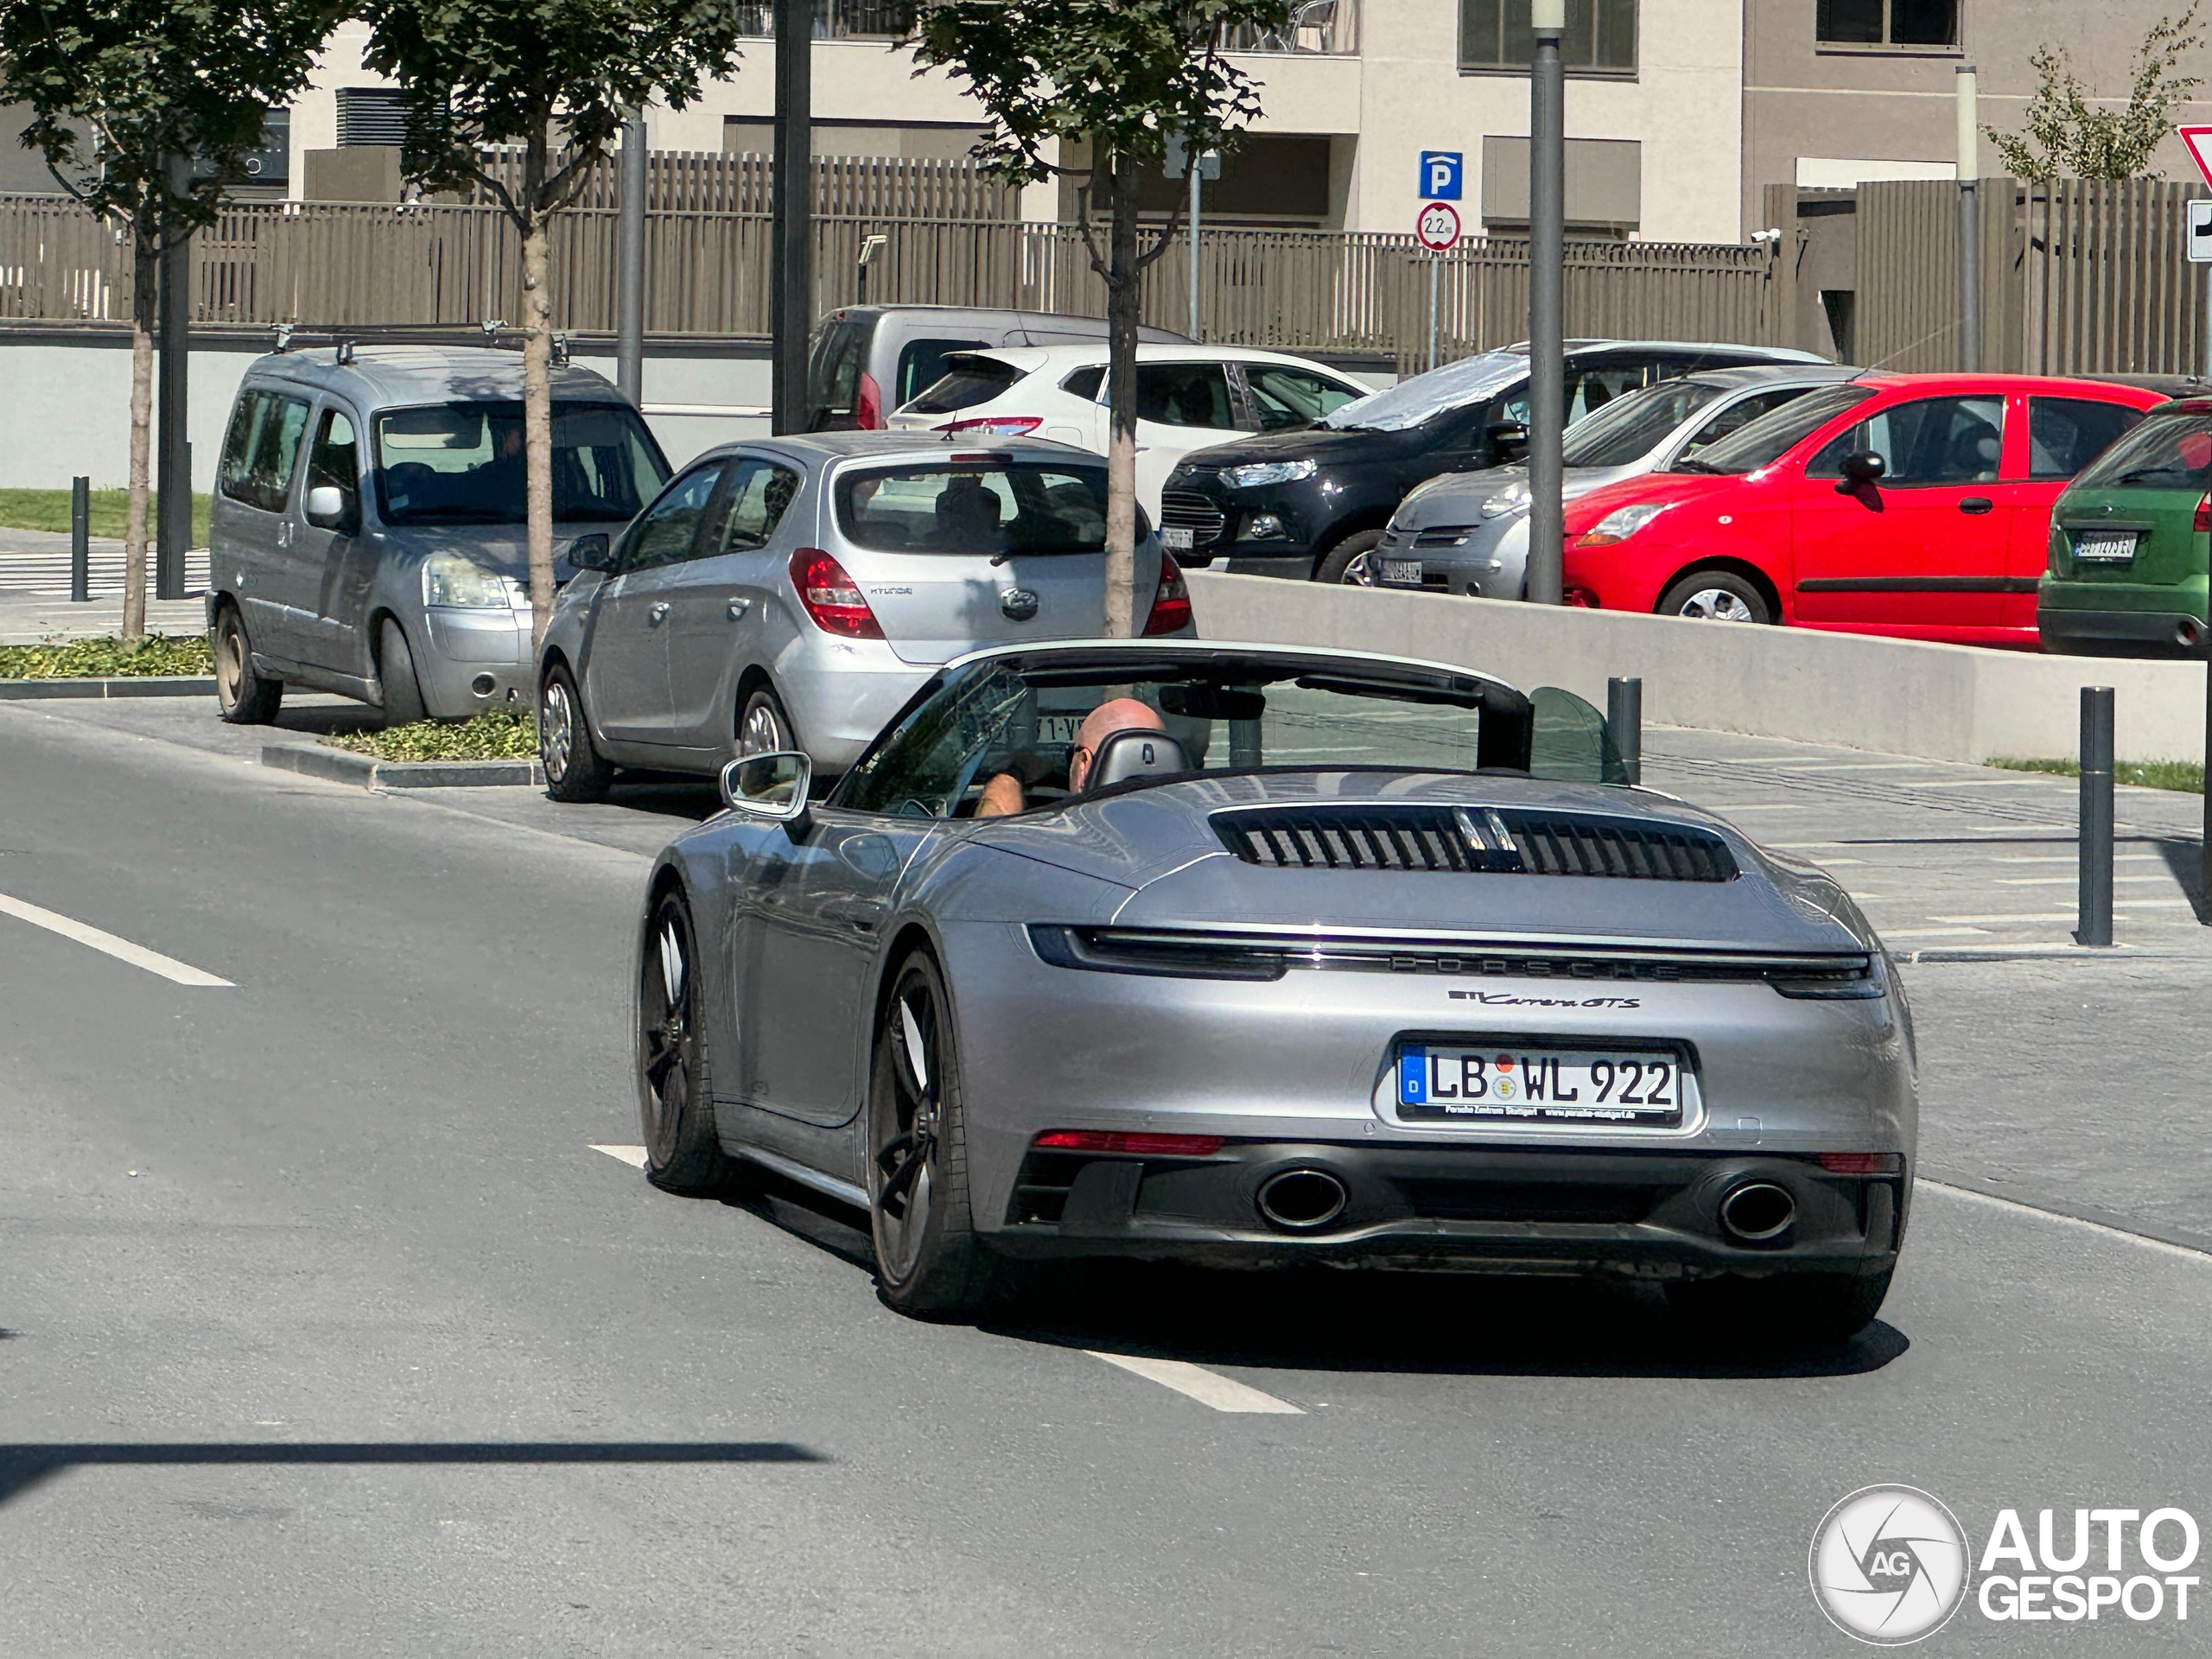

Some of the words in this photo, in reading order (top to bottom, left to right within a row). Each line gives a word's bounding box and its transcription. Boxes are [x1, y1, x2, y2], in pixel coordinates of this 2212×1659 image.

[1431, 165, 1451, 194] P
[1480, 994, 1578, 1007] Carrera
[1581, 998, 1640, 1008] GTS
[1431, 1054, 1488, 1098] LB
[1521, 1057, 1579, 1102] WL
[1591, 1060, 1673, 1105] 922
